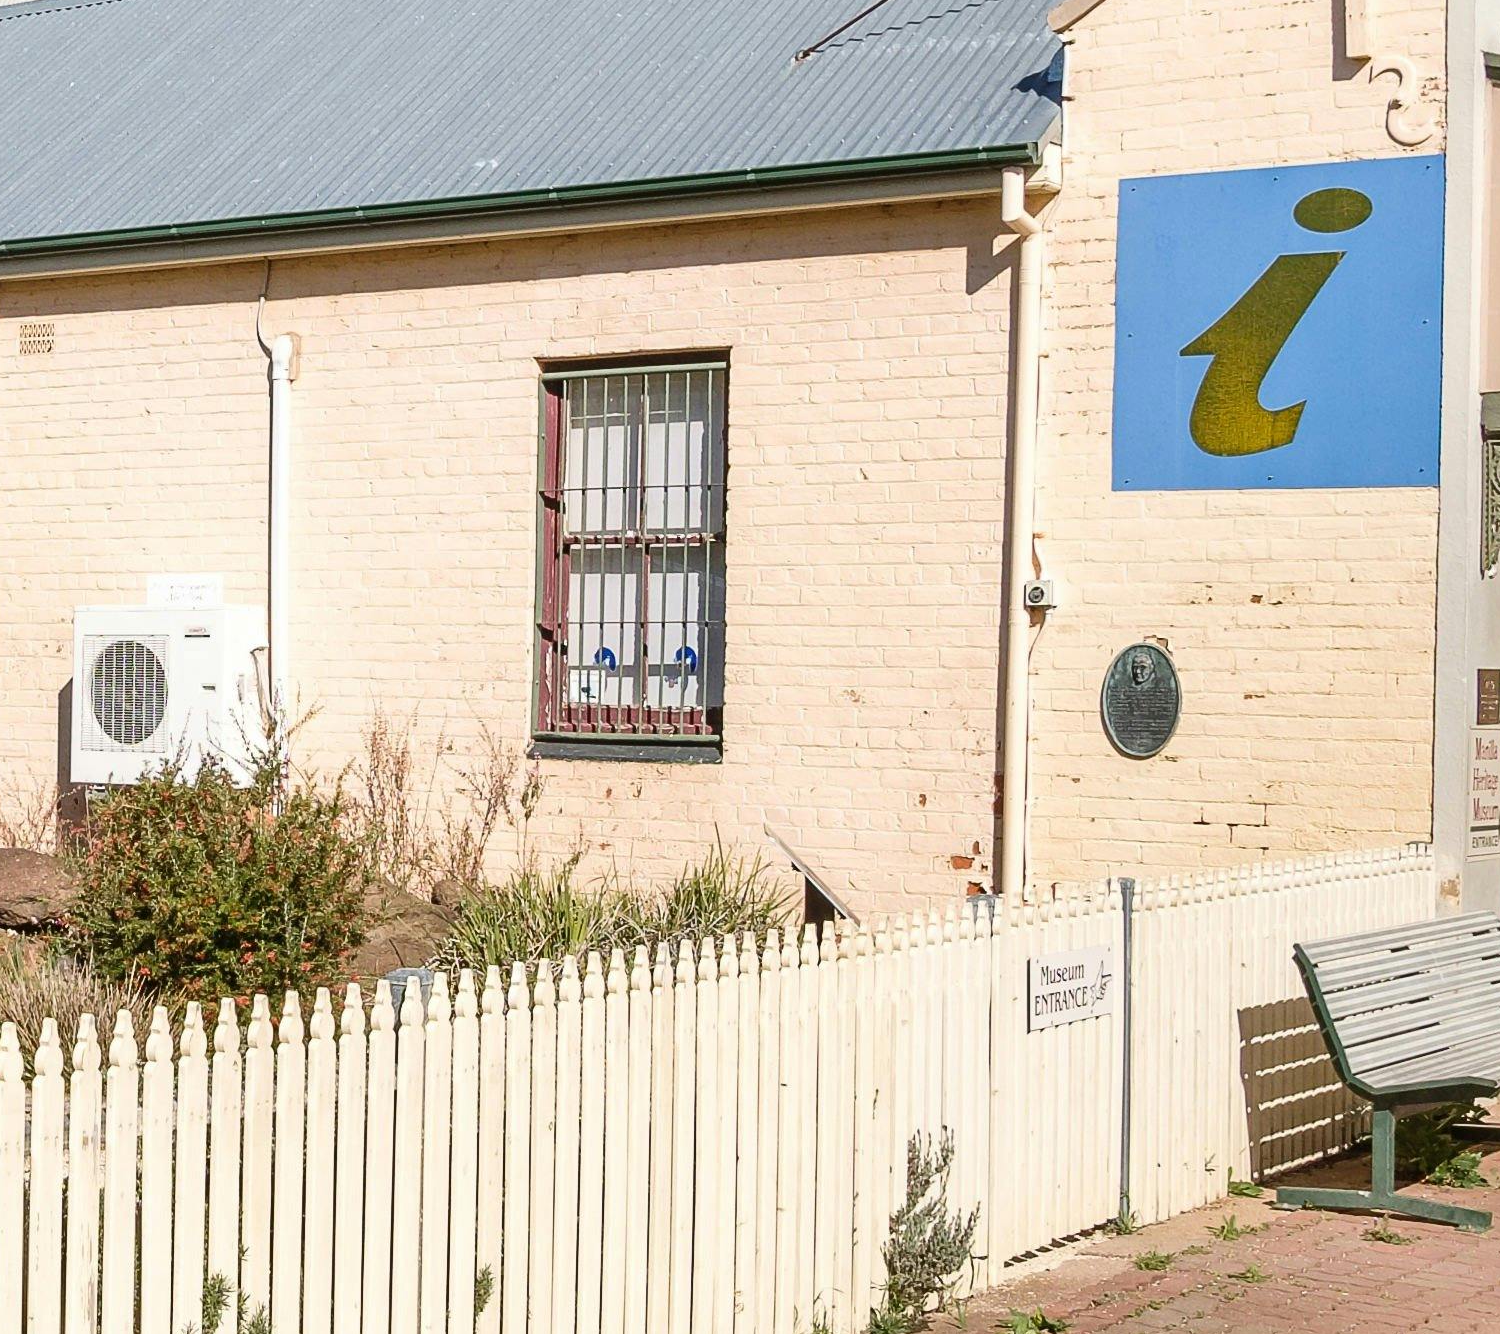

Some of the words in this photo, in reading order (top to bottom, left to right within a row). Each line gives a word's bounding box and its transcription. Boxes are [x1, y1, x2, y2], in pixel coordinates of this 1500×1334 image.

[1473, 798, 1499, 822] Museum
[1472, 835, 1499, 849] ENTRANCE
[1040, 963, 1085, 986] Museum
[1034, 987, 1089, 1016] ENTRANCE
